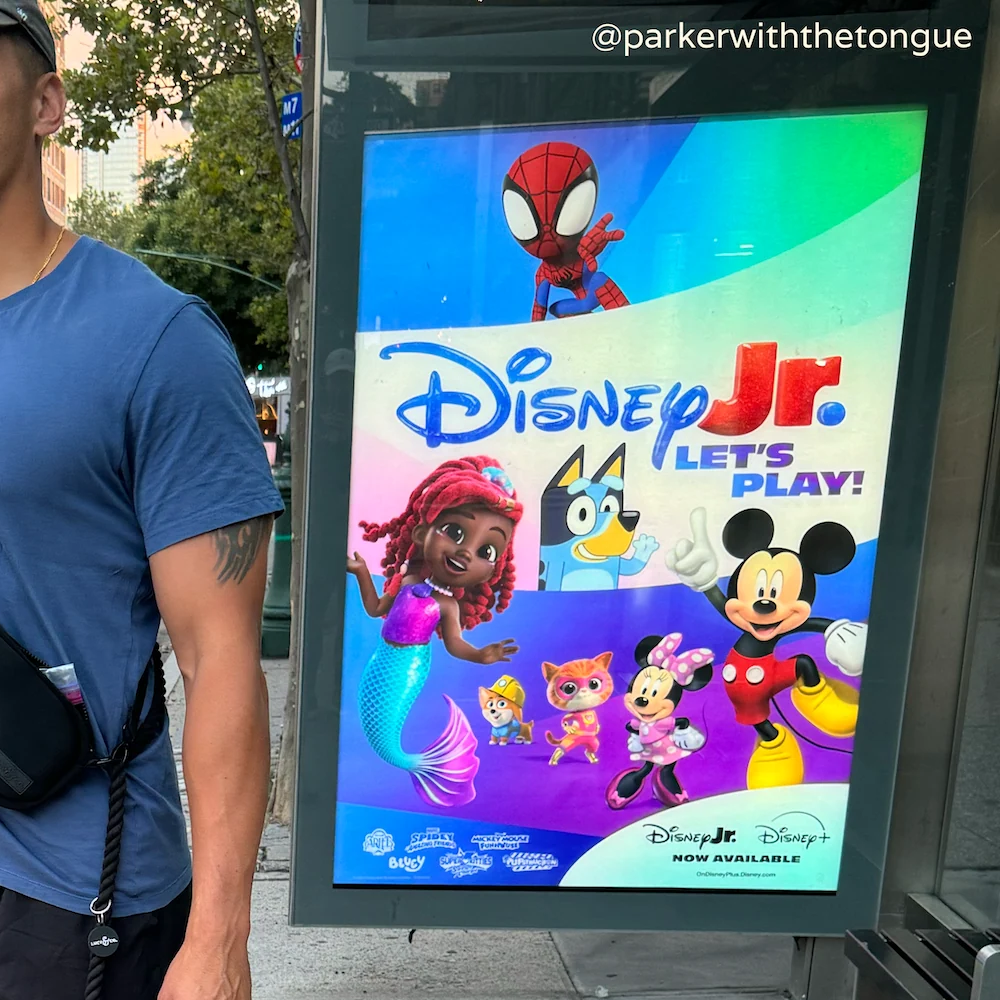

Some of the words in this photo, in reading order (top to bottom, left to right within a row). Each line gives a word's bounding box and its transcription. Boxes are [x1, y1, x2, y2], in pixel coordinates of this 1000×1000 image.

[283, 97, 298, 115] M7
[698, 341, 847, 437] Jr.
[675, 443, 795, 470] LET'S
[731, 471, 864, 498] PLAY!
[710, 827, 737, 844] Jr.
[672, 854, 708, 863] NOW
[712, 854, 801, 864] AVAILABLE
